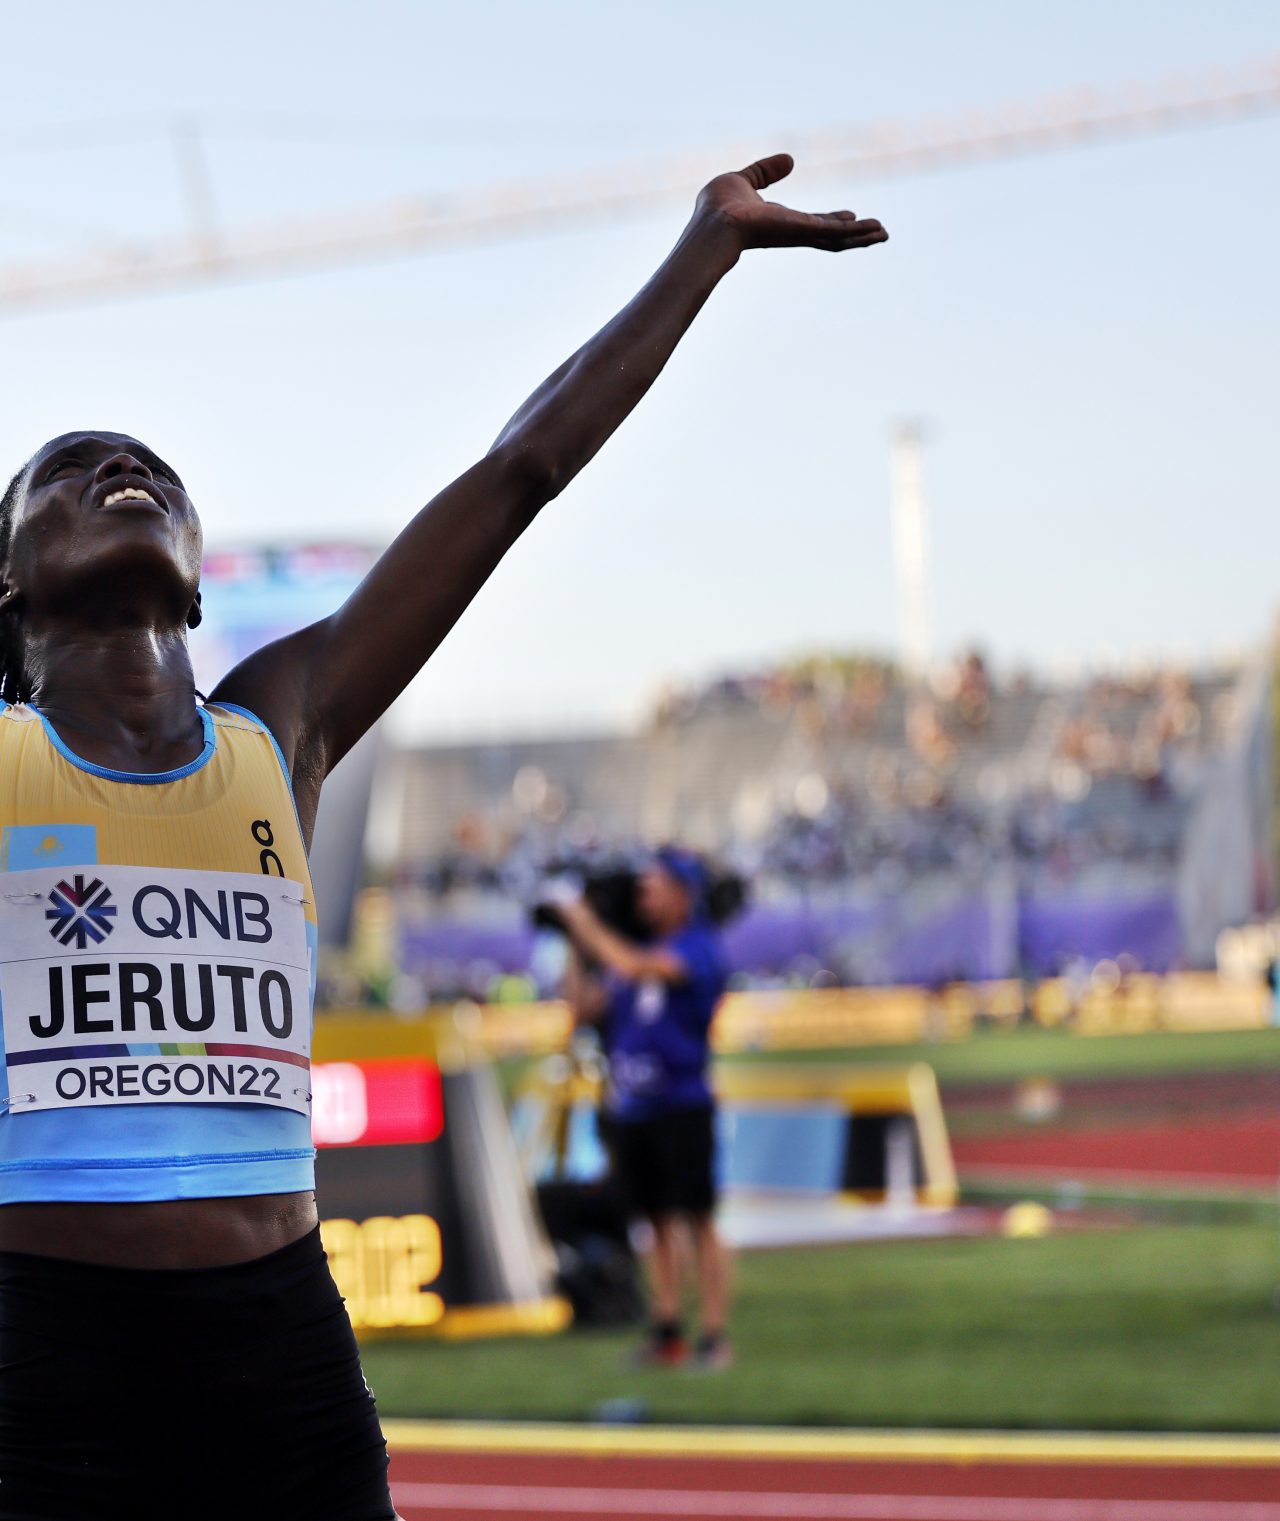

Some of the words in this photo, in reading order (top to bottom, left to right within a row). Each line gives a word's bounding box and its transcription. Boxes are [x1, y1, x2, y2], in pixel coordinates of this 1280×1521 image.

[132, 885, 272, 943] QNB
[29, 963, 293, 1039] JERUTO
[55, 1063, 282, 1100] OREGON22
